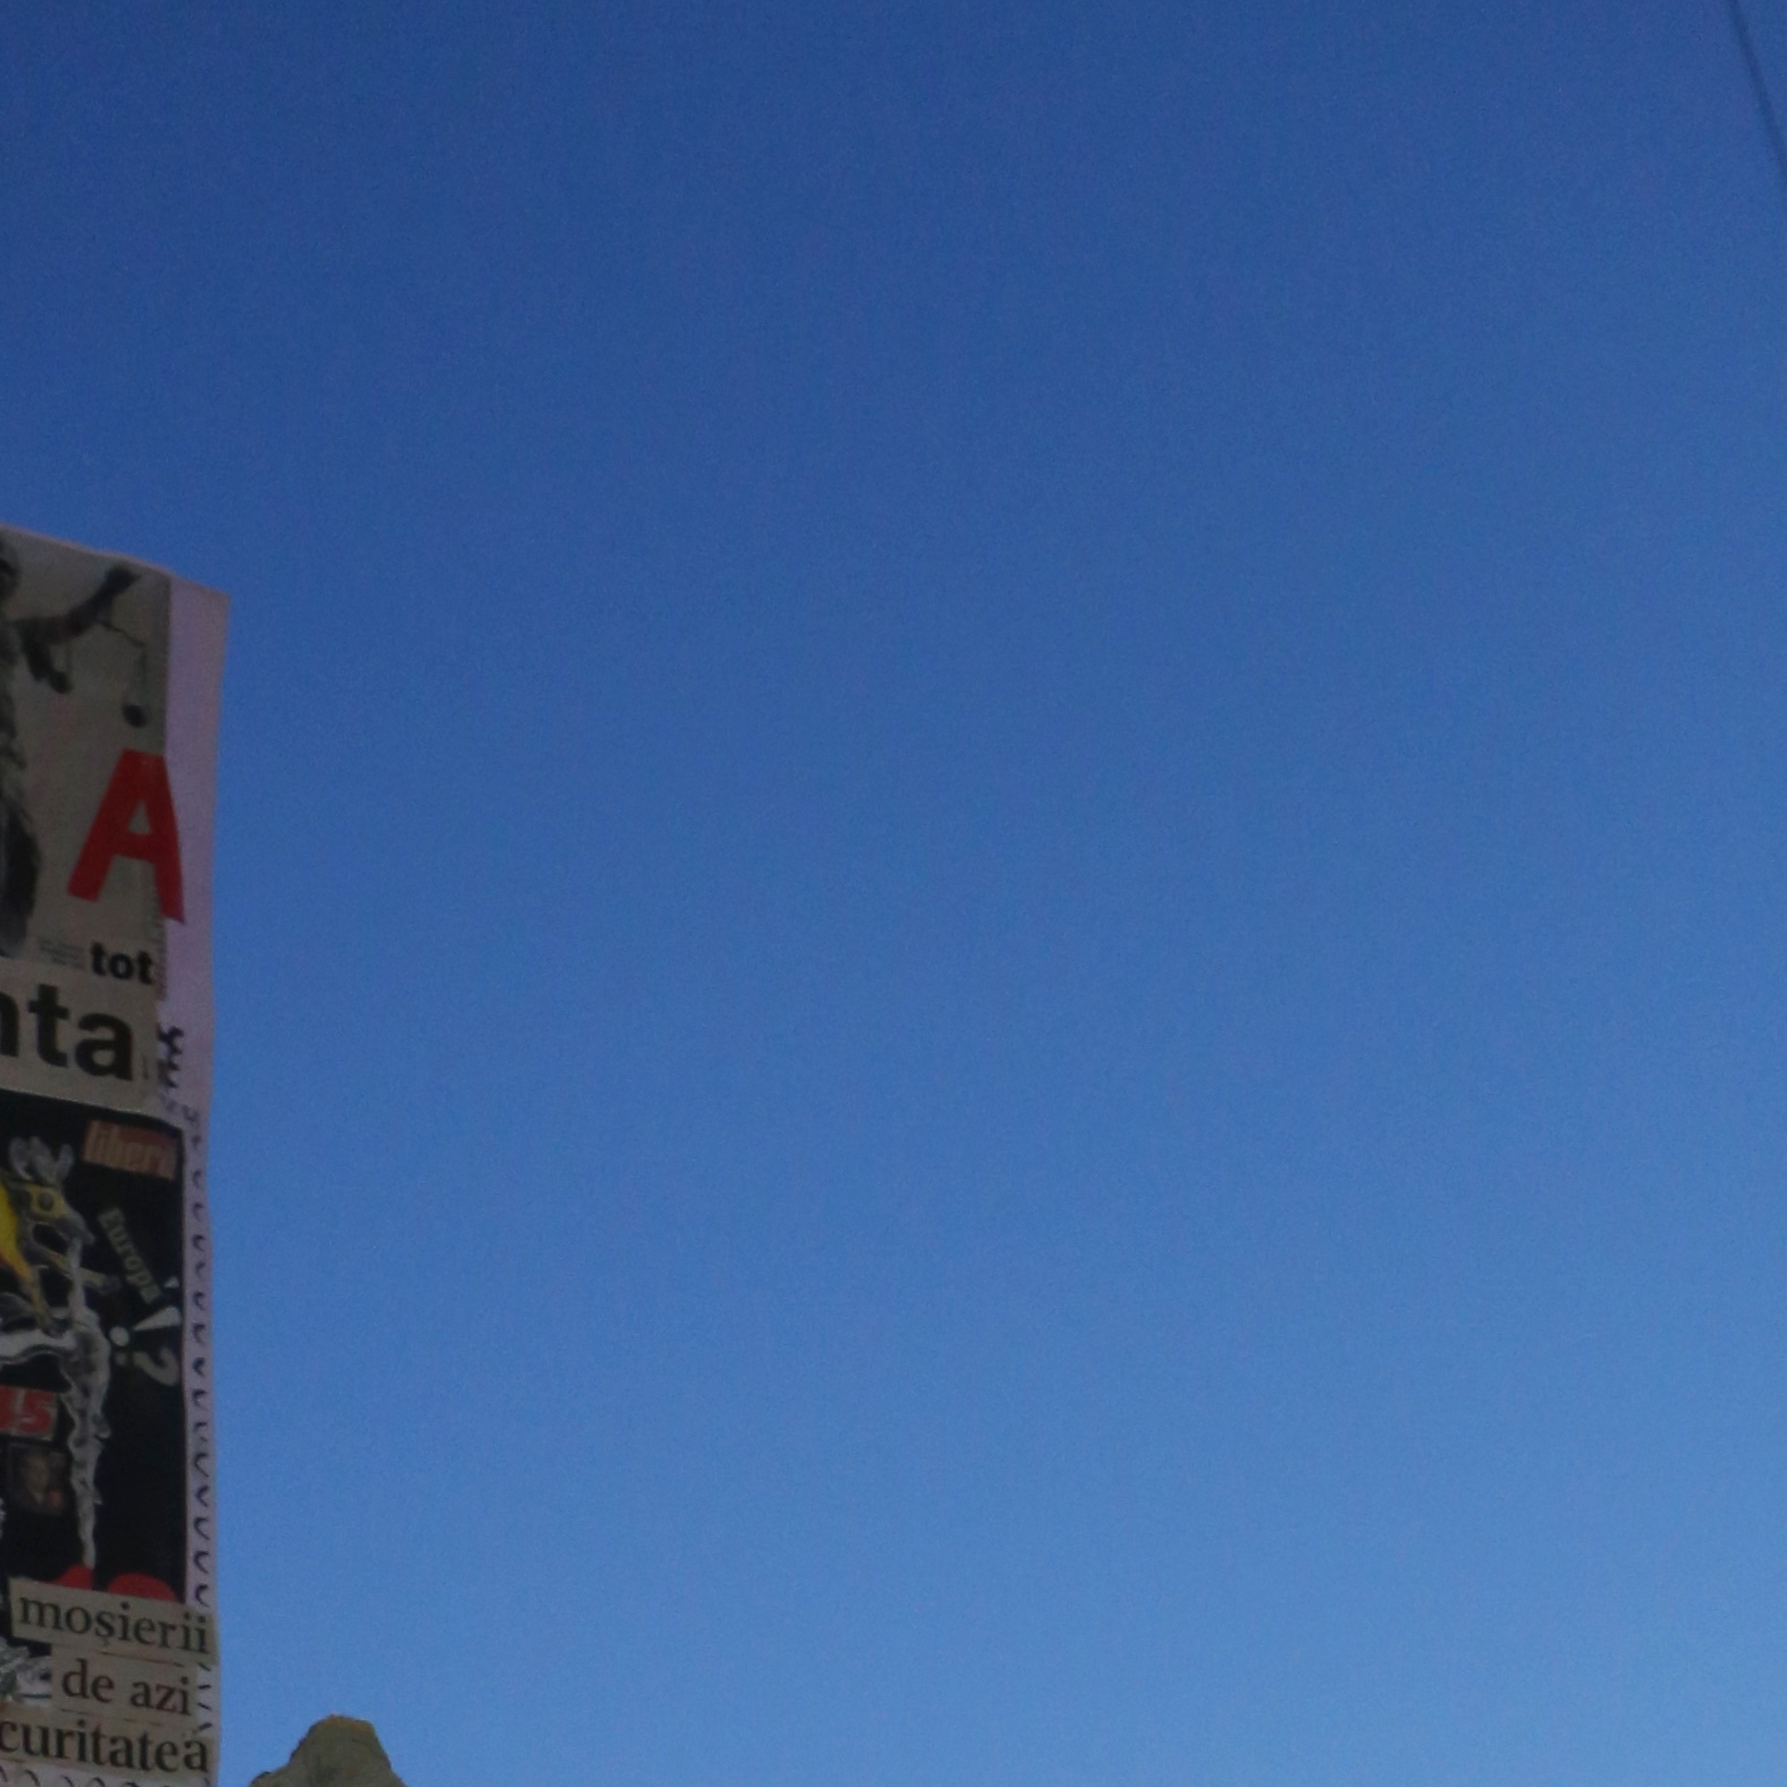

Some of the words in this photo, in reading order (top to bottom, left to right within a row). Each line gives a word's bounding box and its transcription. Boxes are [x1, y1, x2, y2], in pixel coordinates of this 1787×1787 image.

[68, 748, 186, 924] A
[91, 942, 153, 985] tot
[20, 1596, 209, 1655] moșierii
[63, 1658, 114, 1702] de
[130, 1677, 190, 1715] azi
